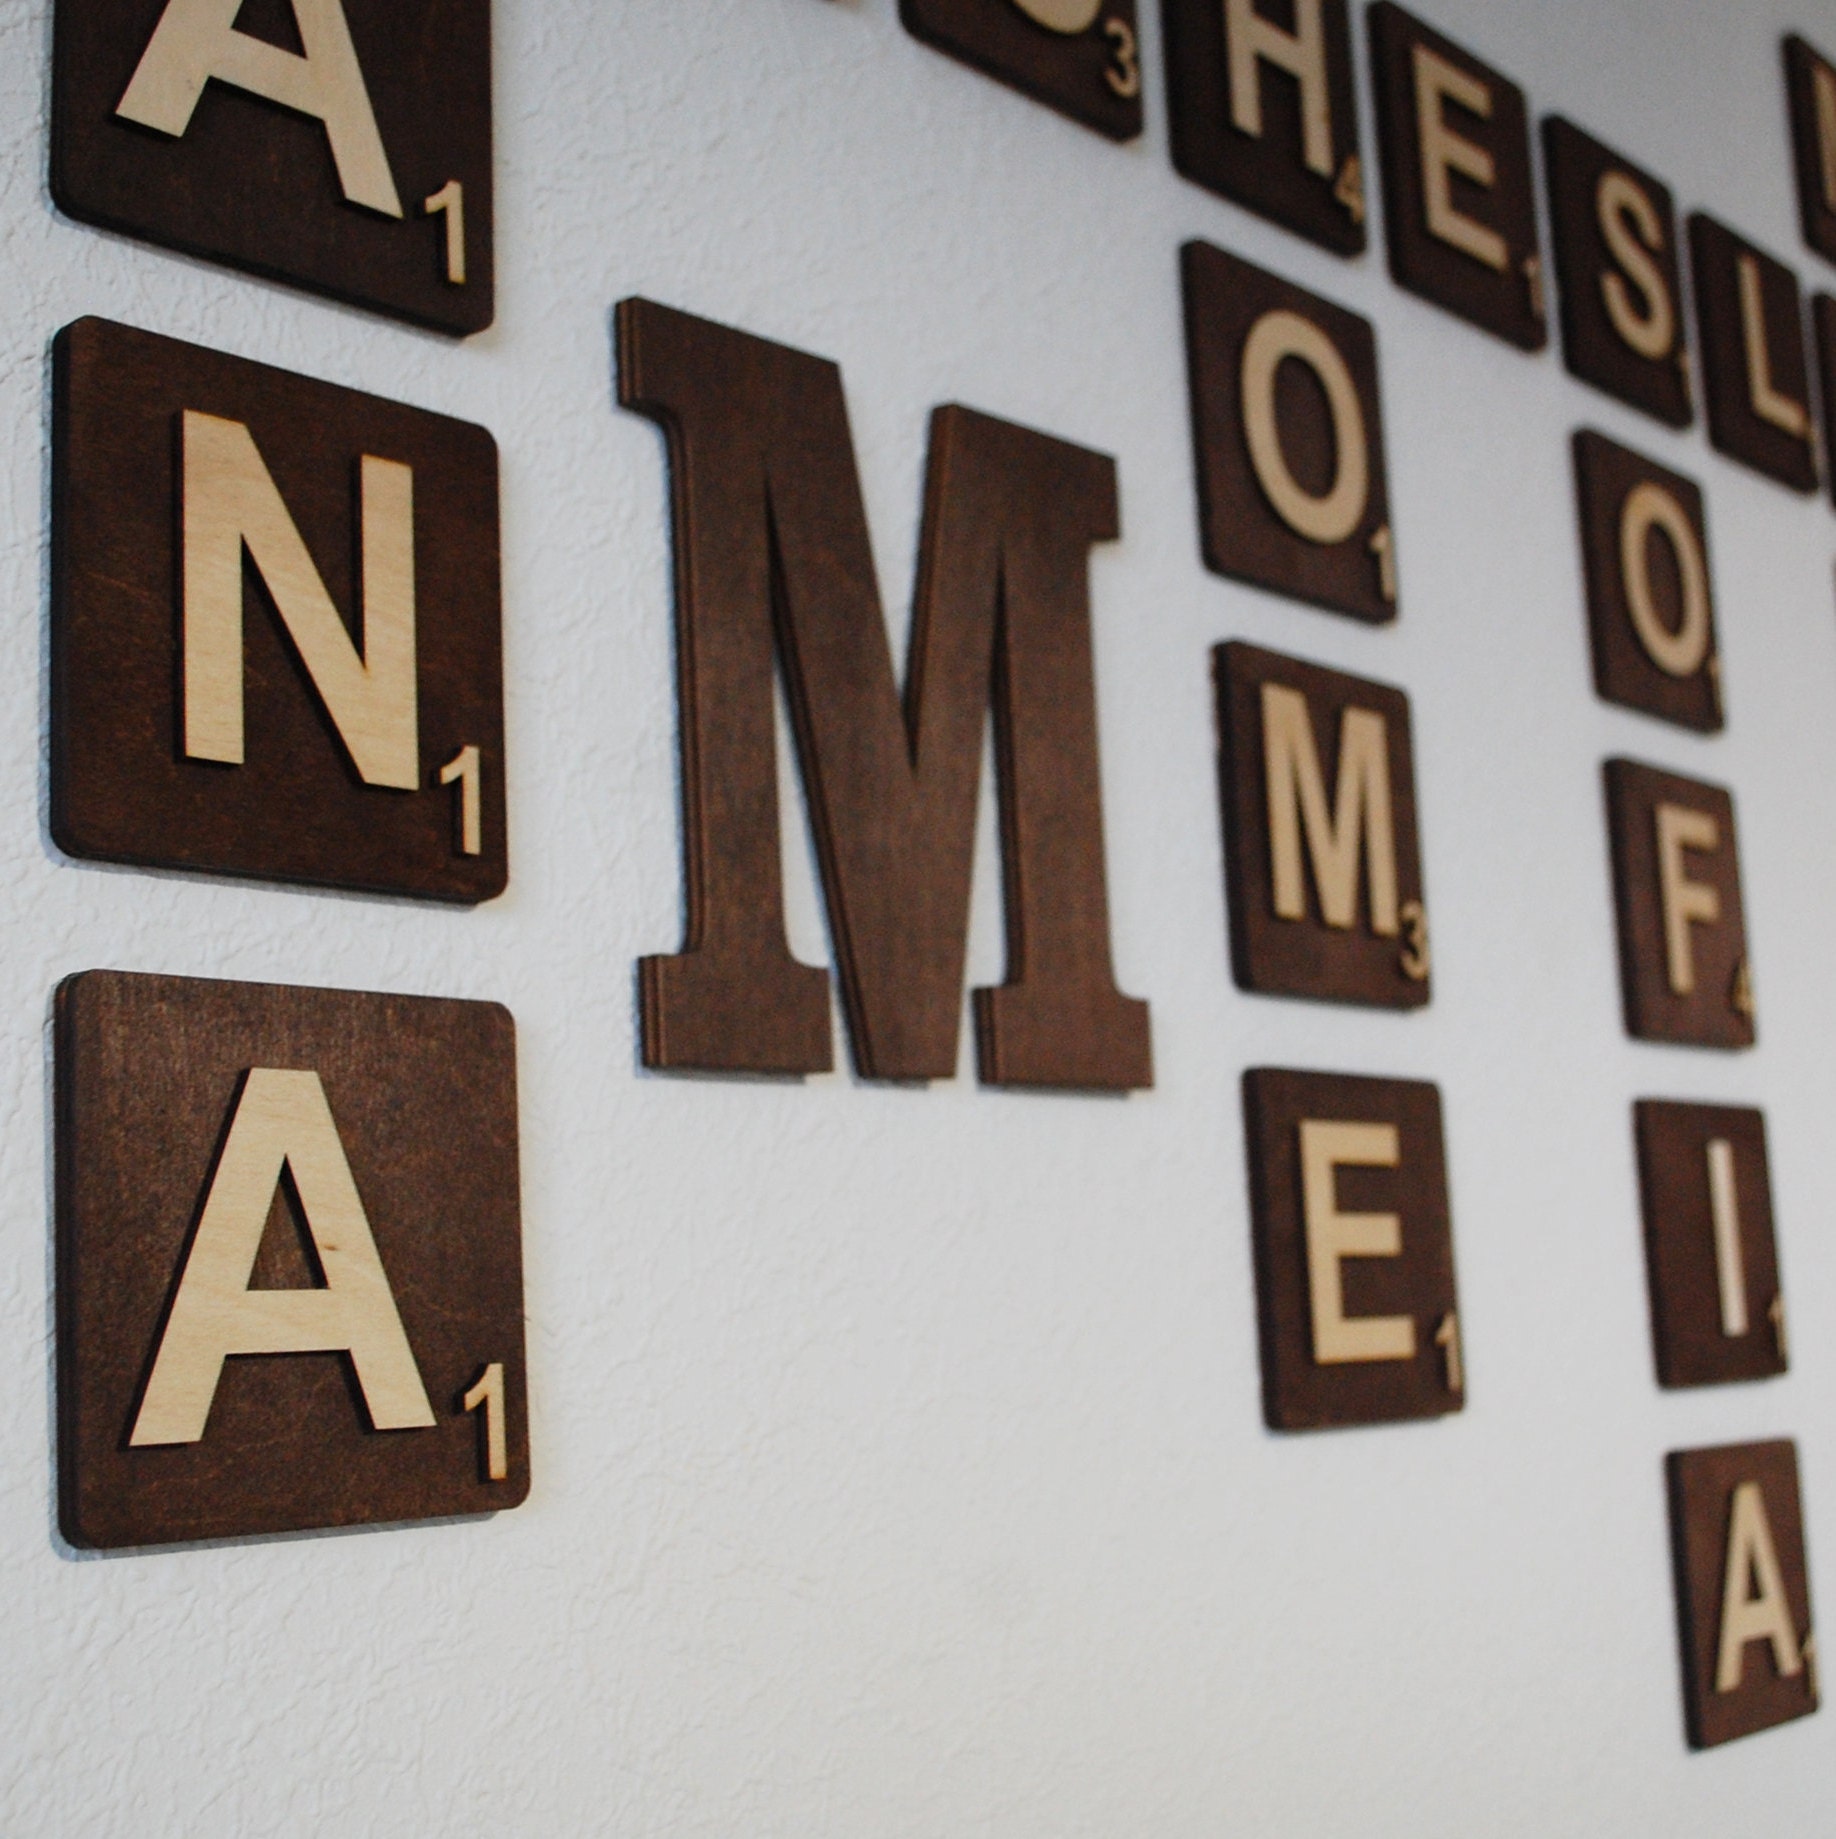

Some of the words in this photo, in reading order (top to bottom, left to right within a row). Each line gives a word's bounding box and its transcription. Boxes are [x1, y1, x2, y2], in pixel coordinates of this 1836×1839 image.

[114, 0, 402, 219] A
[424, 180, 465, 285] 1
[1105, 18, 1138, 97] 3
[1226, 0, 1335, 178] H
[1413, 45, 1509, 270] E
[1599, 171, 1675, 359] S
[1739, 255, 1809, 437] L
[1242, 310, 1367, 542] O
[182, 410, 420, 790] N
[440, 745, 482, 856] 1
[1621, 484, 1708, 676] O
[616, 298, 1154, 1094] M
[1261, 684, 1400, 936] M
[1656, 803, 1720, 996] F
[128, 1067, 437, 1447] A
[464, 1362, 507, 1481] 1
[1300, 1120, 1416, 1365] E
[1435, 1311, 1462, 1391] 1
[1715, 1481, 1801, 1693] A
